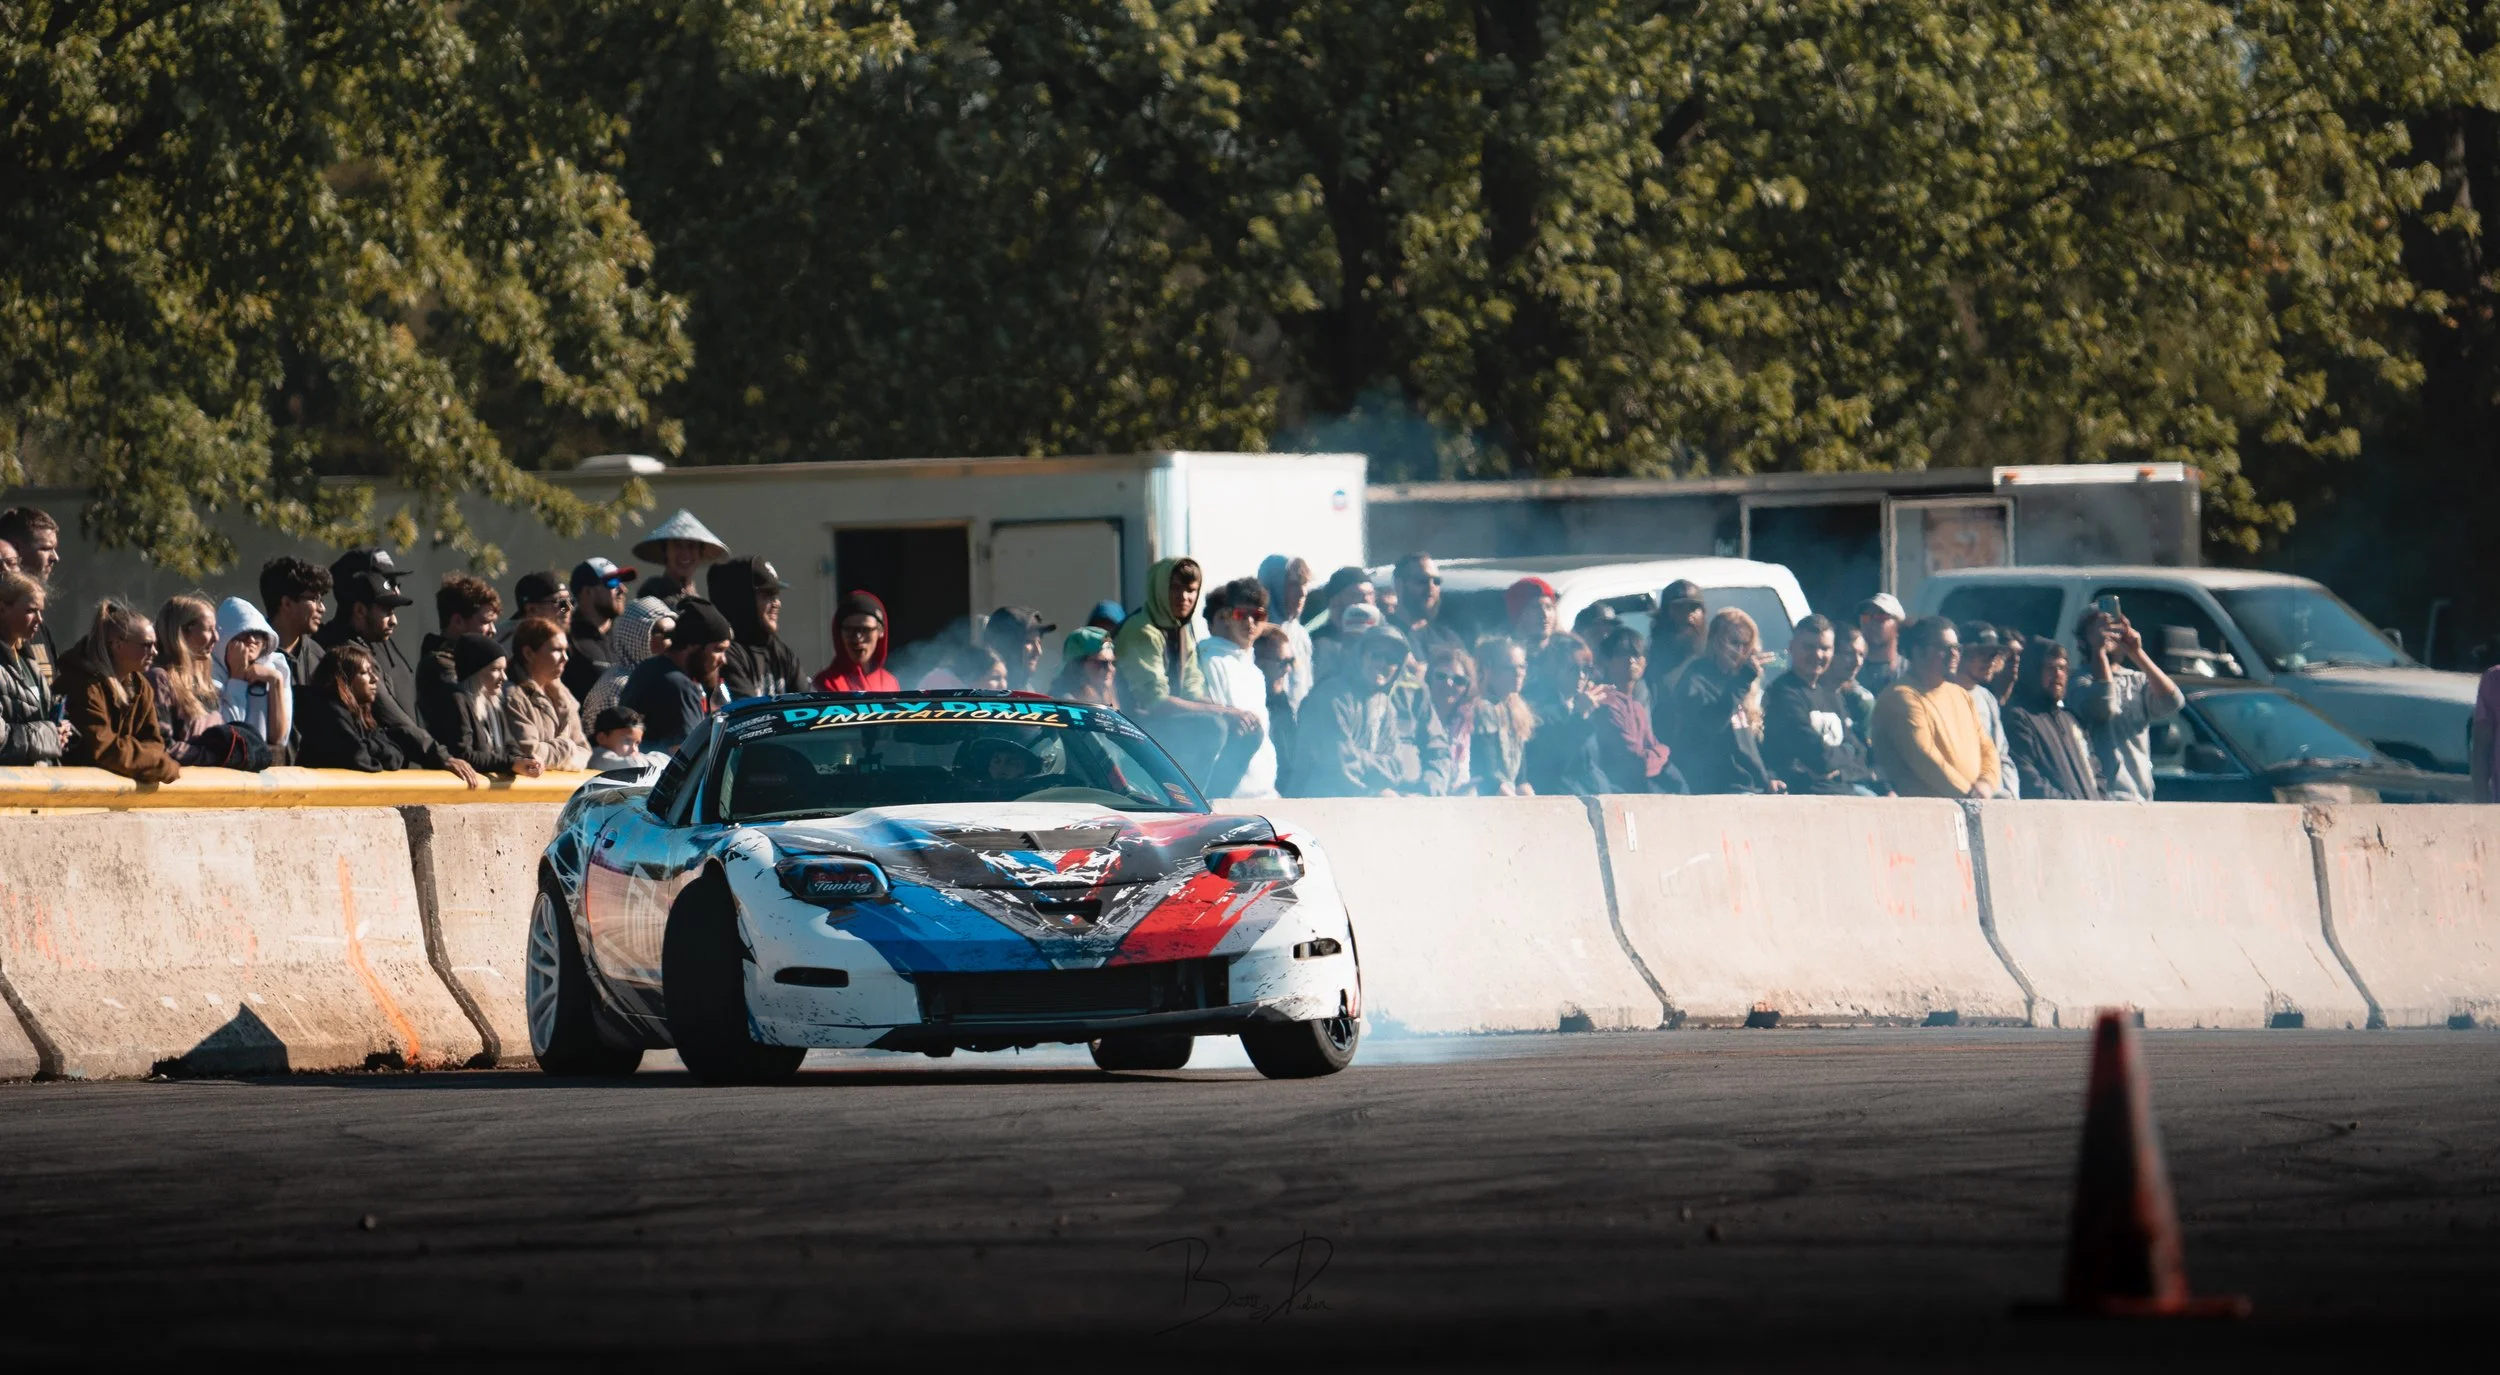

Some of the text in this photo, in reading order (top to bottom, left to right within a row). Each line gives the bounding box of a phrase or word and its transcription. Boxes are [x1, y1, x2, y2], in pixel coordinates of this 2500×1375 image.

[782, 701, 1089, 722] DAILY DRIFT
[816, 709, 1060, 725] INVITATIONAL
[814, 880, 871, 893] Tuning
